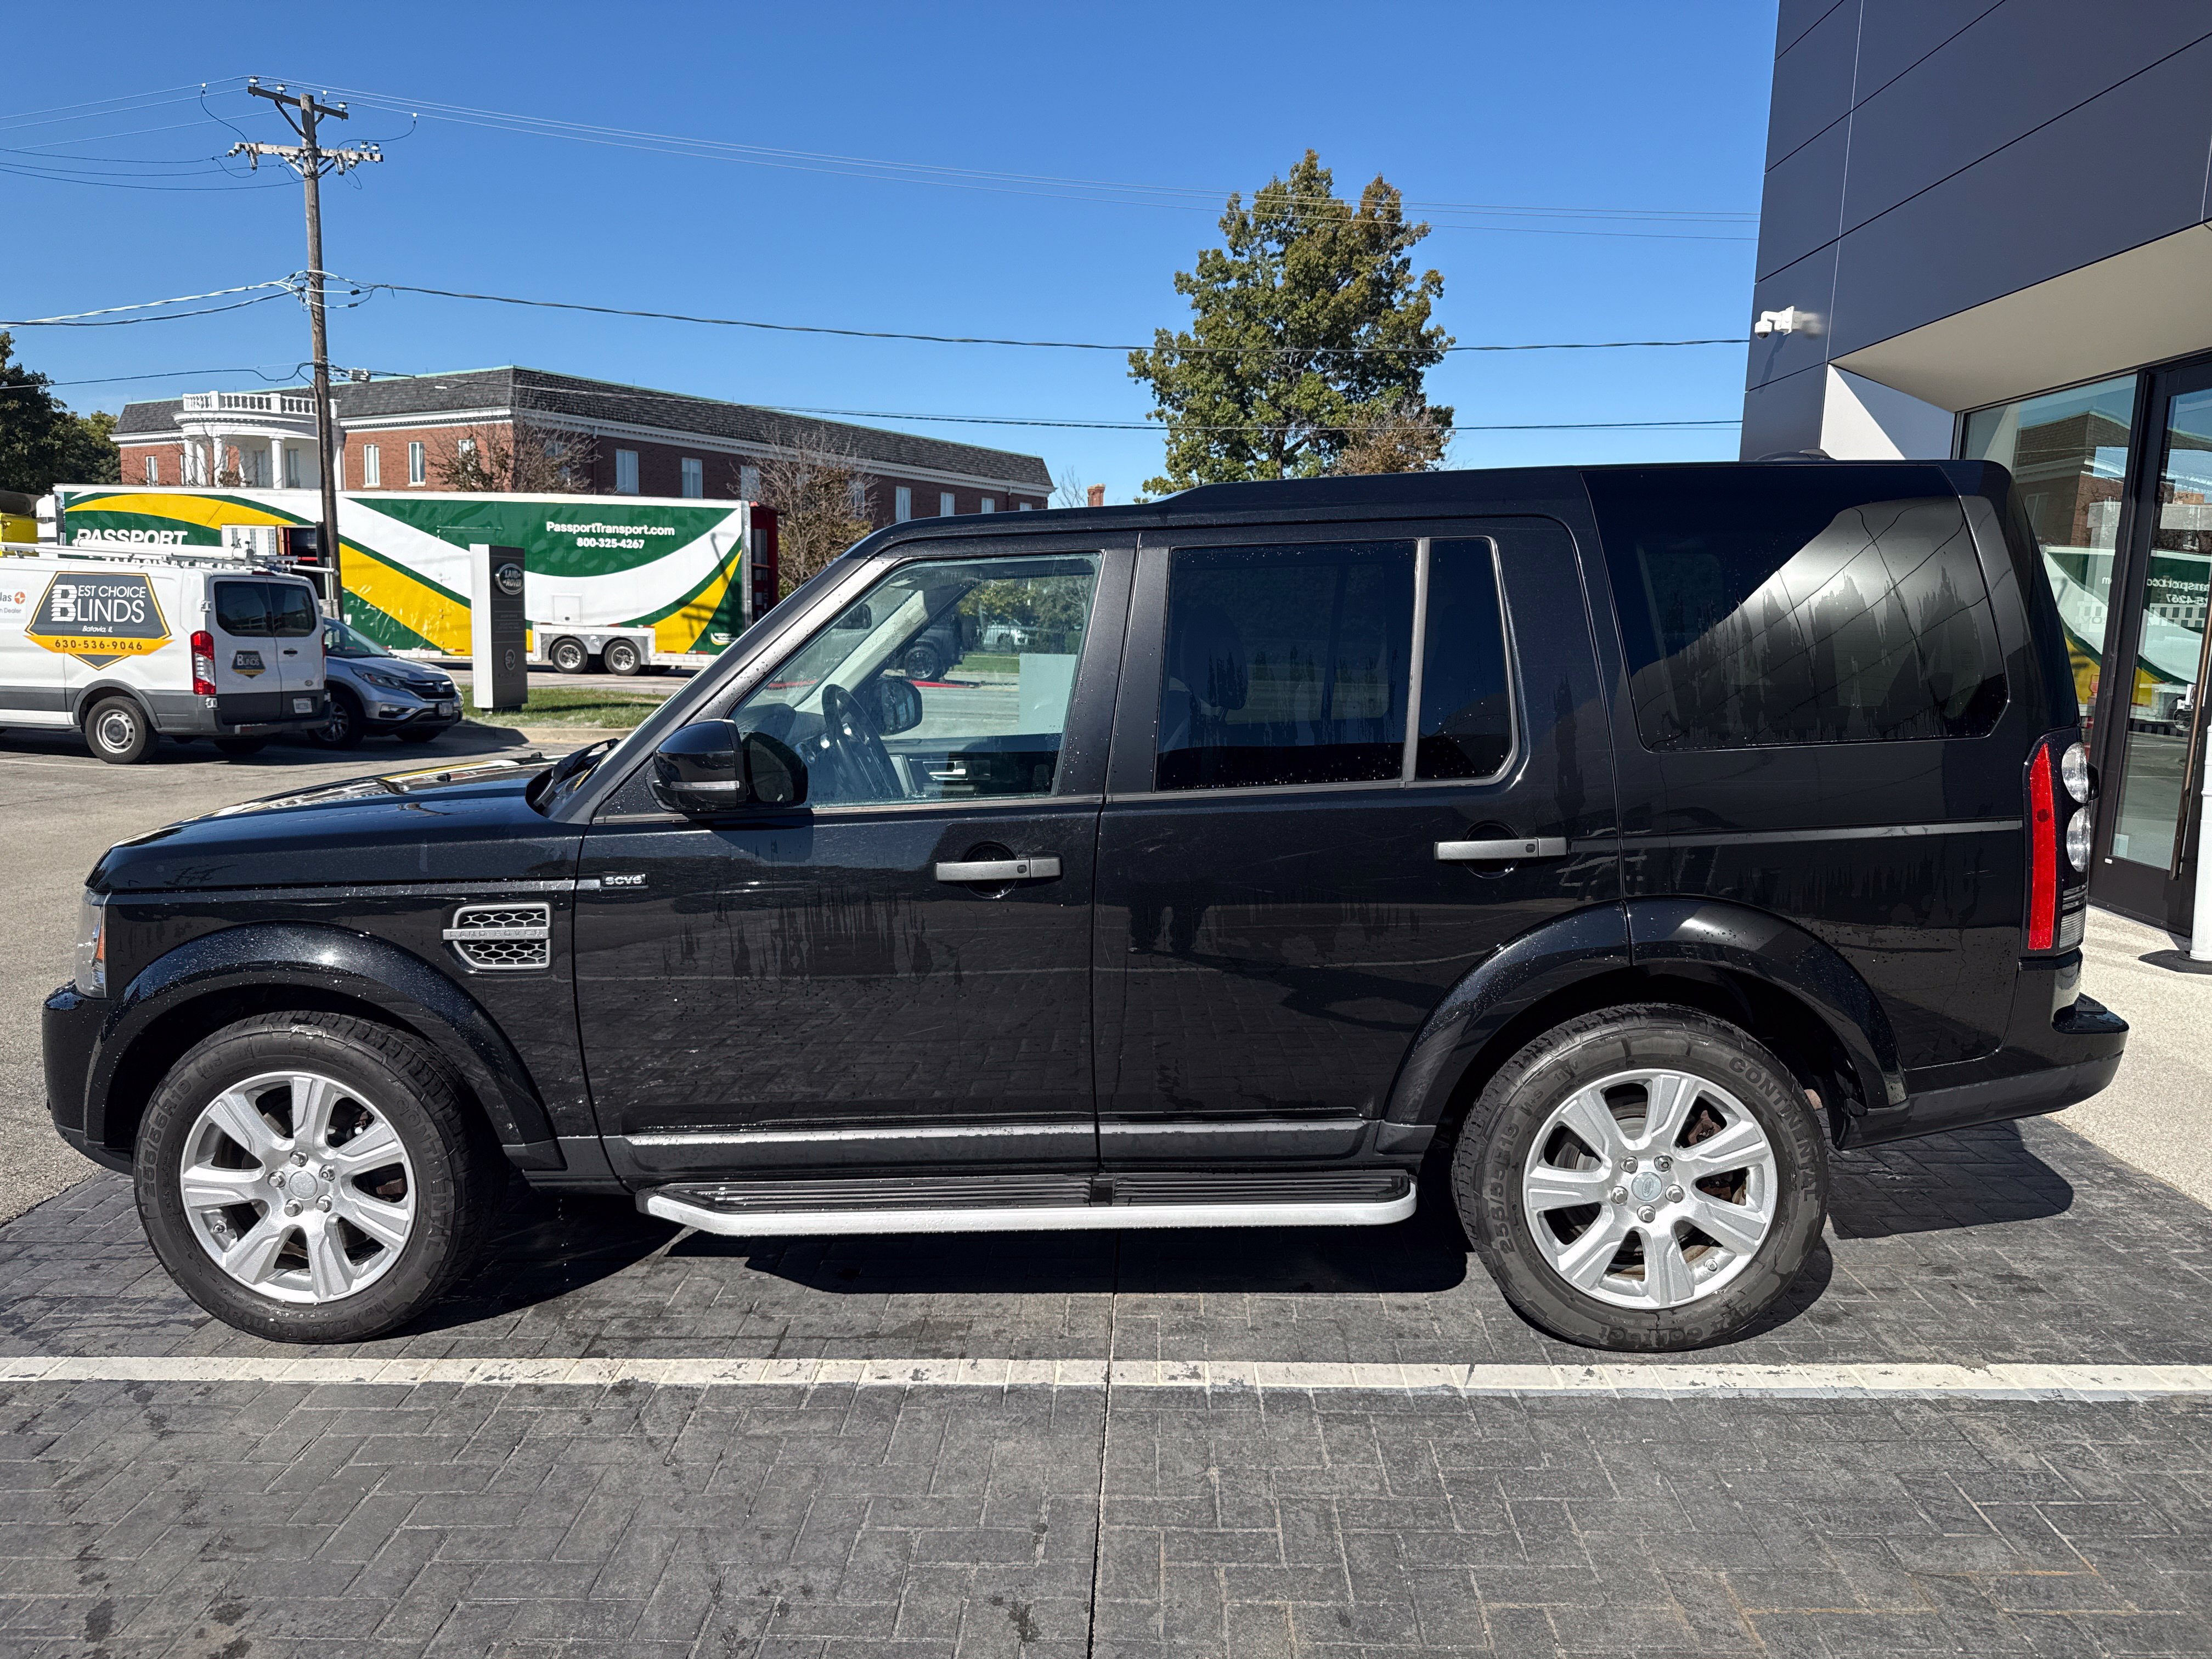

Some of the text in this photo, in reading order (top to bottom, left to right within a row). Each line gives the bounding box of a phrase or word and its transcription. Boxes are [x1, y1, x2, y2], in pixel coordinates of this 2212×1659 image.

[546, 521, 675, 535] PassportTransport.com
[577, 537, 645, 549] 800-325-4267
[98, 586, 146, 598] CHOICE
[51, 584, 145, 623] BLINDS
[55, 639, 143, 651] 630-536-9046
[605, 876, 643, 885] SCV6
[449, 929, 544, 938] LAND ROVER
[1520, 1088, 1544, 1116] M+S
[142, 1079, 191, 1198] 255/55R19
[1729, 1057, 1816, 1202] CONTINENTAL
[396, 1098, 447, 1251] CONTINENTAL
[1489, 1122, 1519, 1254] 255/55R19
